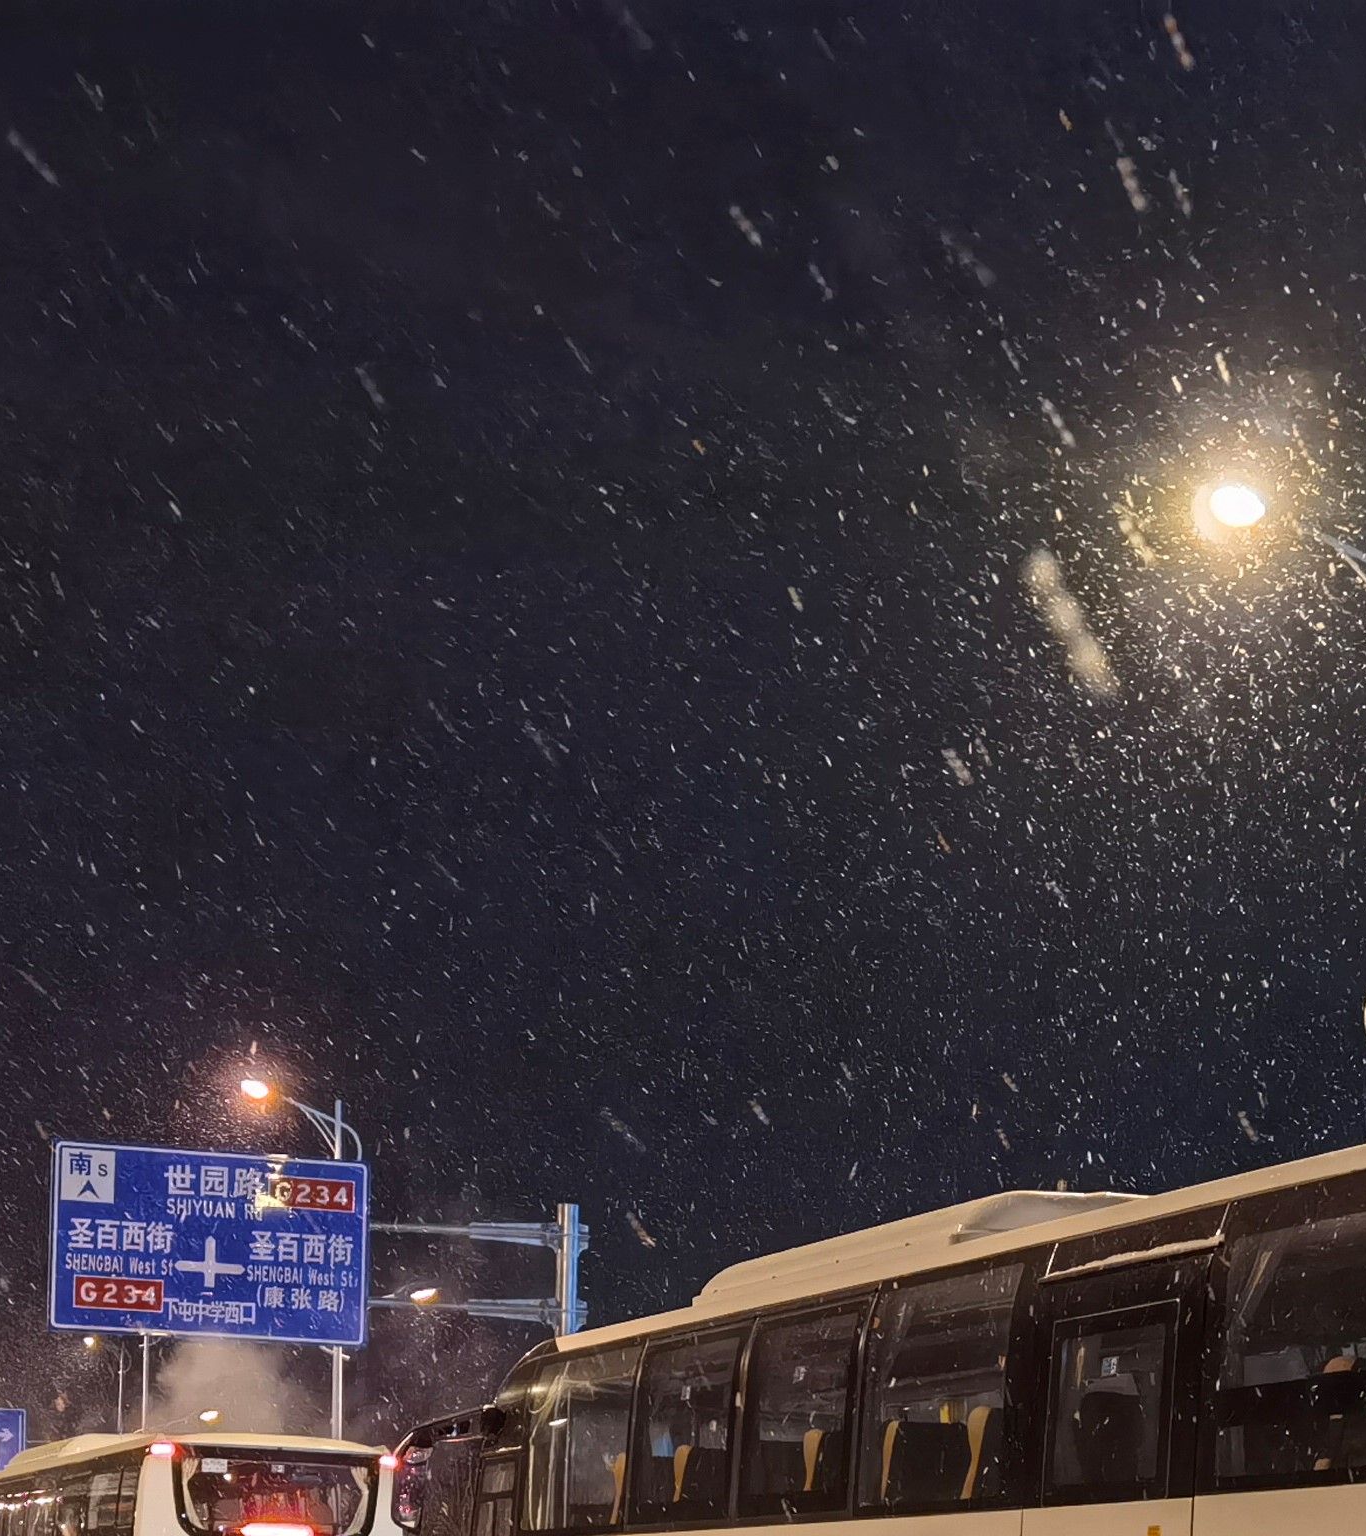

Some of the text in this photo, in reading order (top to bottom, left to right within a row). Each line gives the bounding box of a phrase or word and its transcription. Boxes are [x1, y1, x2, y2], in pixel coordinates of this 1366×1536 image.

[69, 1152, 108, 1177] 南 S
[163, 1164, 265, 1200] 世园路
[274, 1180, 349, 1206] G234
[165, 1198, 235, 1219] SHIYUAN
[67, 1217, 174, 1254] 圣百西街
[248, 1231, 355, 1266] 圣百西街
[65, 1253, 124, 1274] SHENGBAI
[129, 1257, 156, 1276] West
[246, 1264, 303, 1285] SHENGBAI
[308, 1270, 335, 1288] West
[79, 1281, 157, 1306] G234
